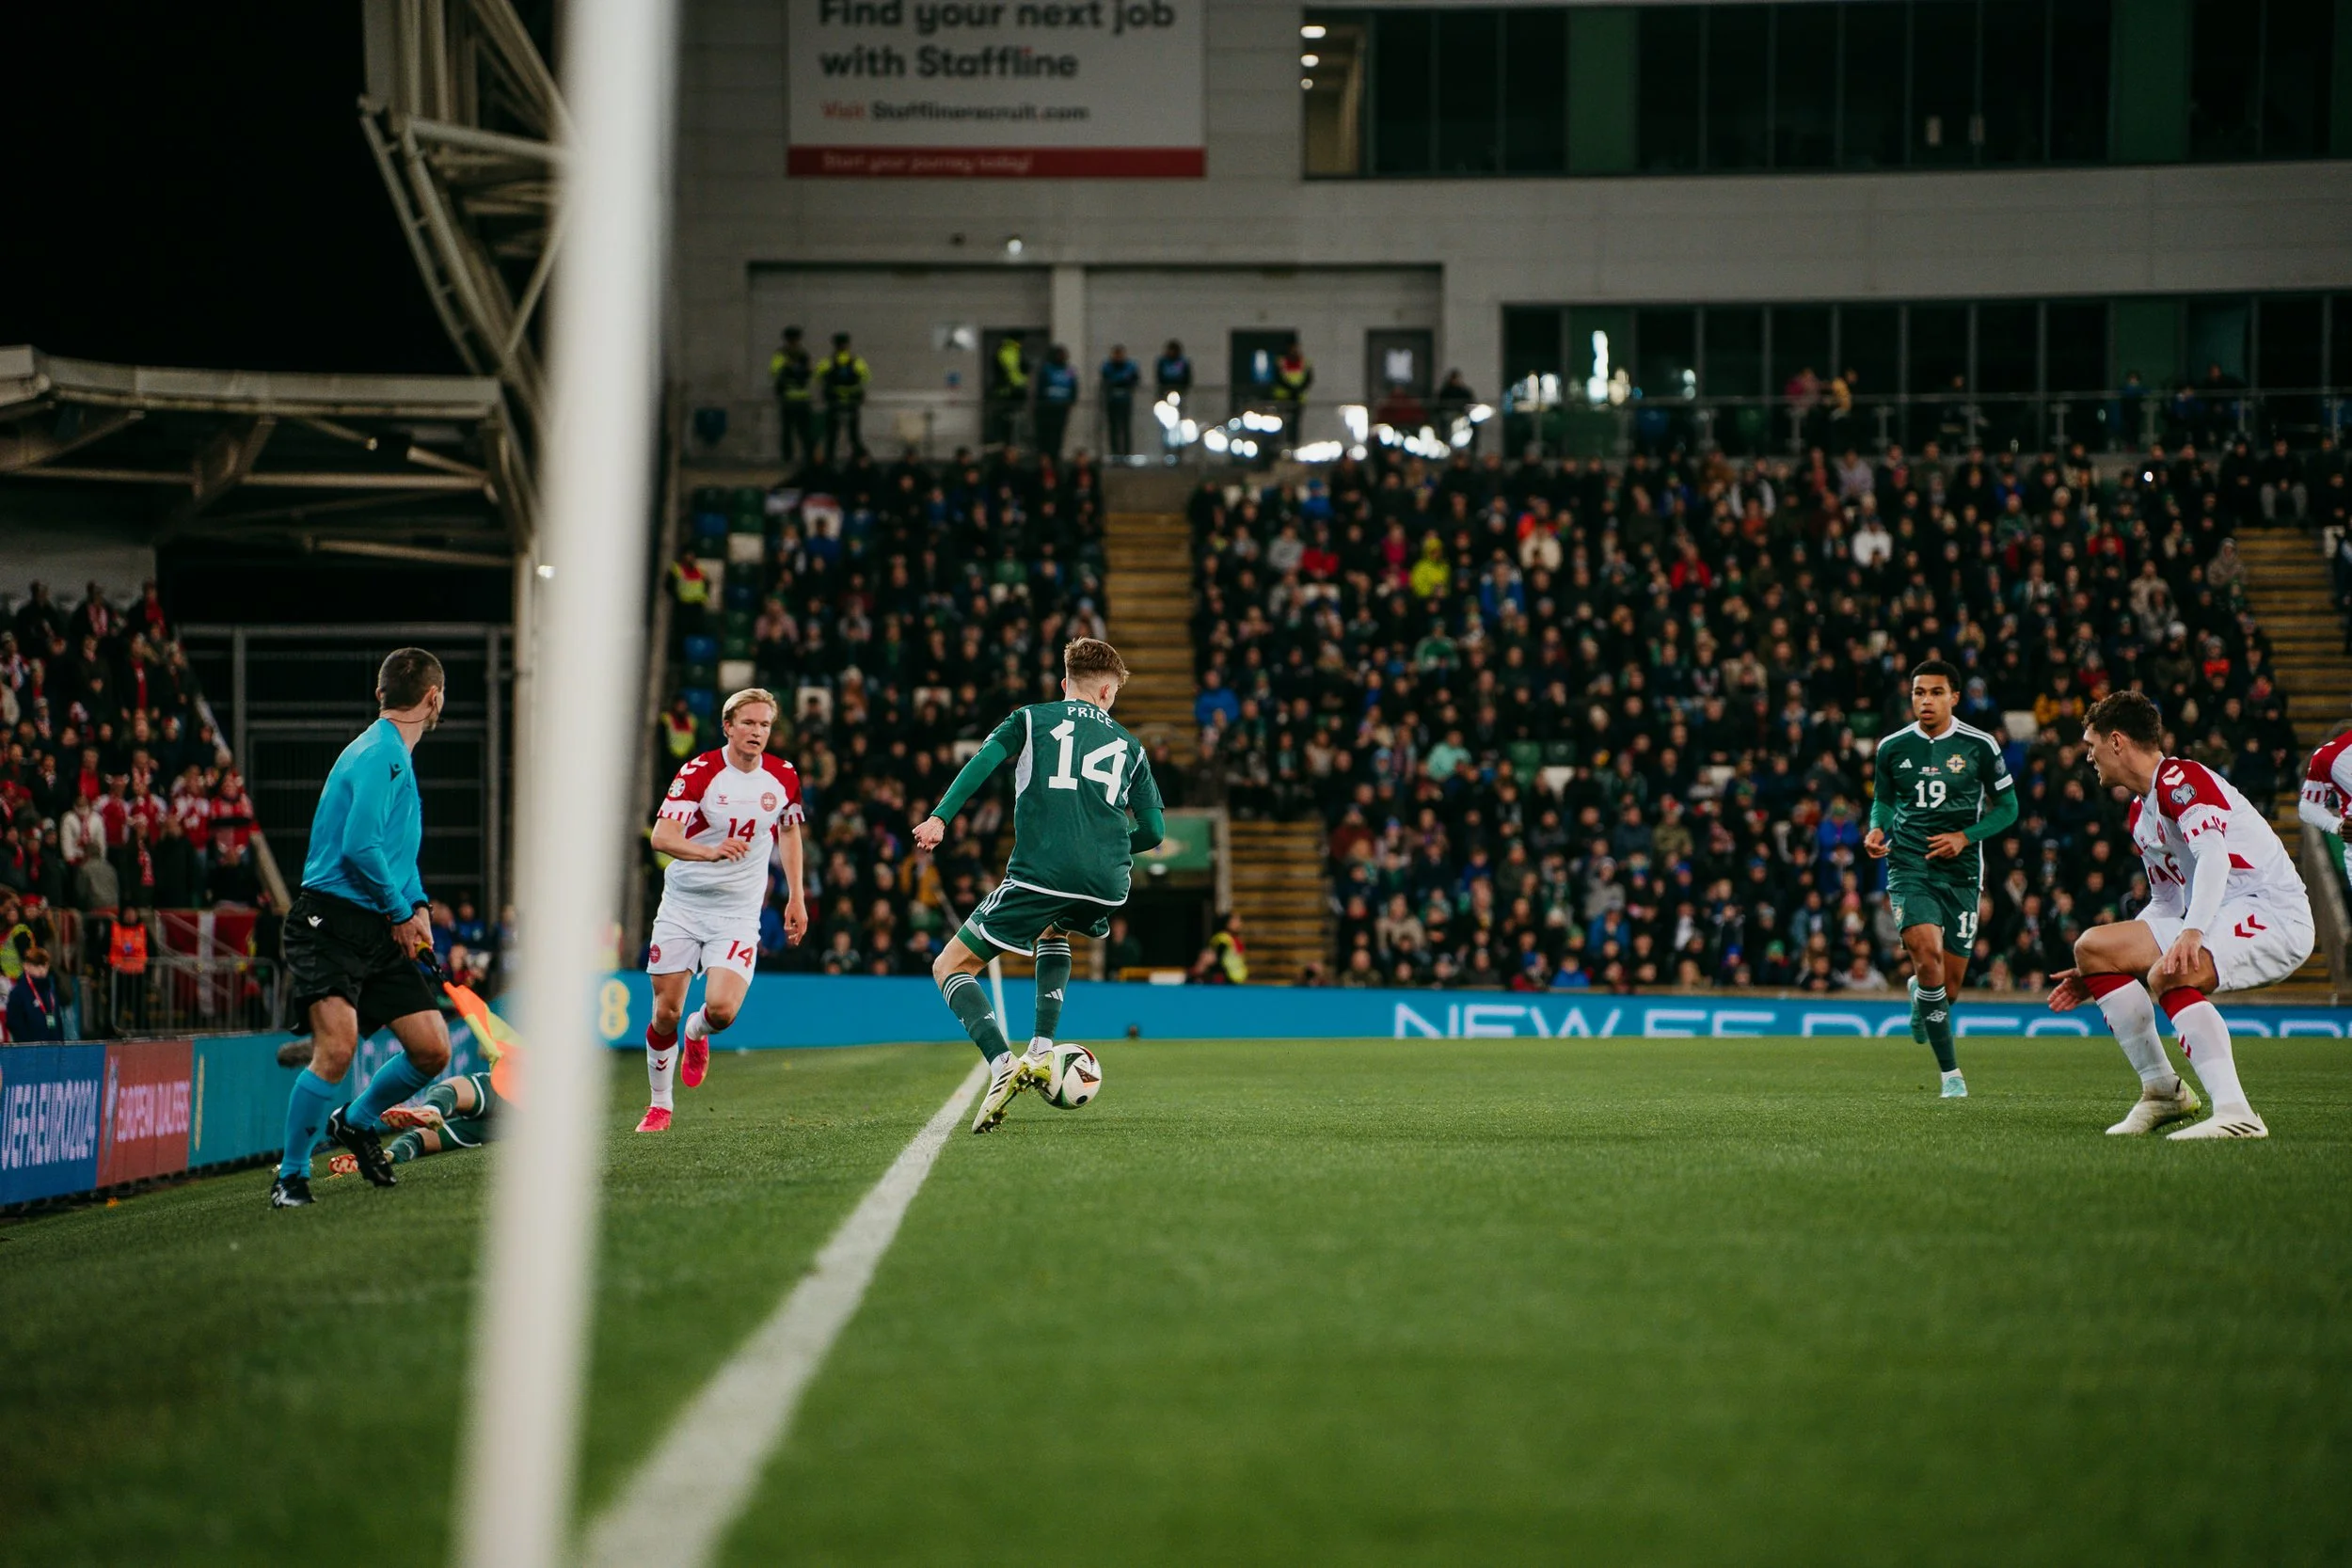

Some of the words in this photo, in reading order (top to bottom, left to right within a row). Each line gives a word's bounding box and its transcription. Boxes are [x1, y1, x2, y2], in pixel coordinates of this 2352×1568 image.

[818, 0, 903, 27] Find
[914, 2, 1004, 36] your
[1017, 0, 1103, 27] next
[1112, 0, 1175, 36] job
[820, 43, 905, 78] with
[916, 43, 1079, 78] Staffline
[821, 100, 866, 120] Visit
[1067, 705, 1114, 729] PRICE
[1048, 719, 1128, 806] 14
[1915, 780, 1947, 809] 19
[727, 817, 756, 843] 14
[1957, 911, 1978, 939] 19
[725, 940, 755, 968] 14
